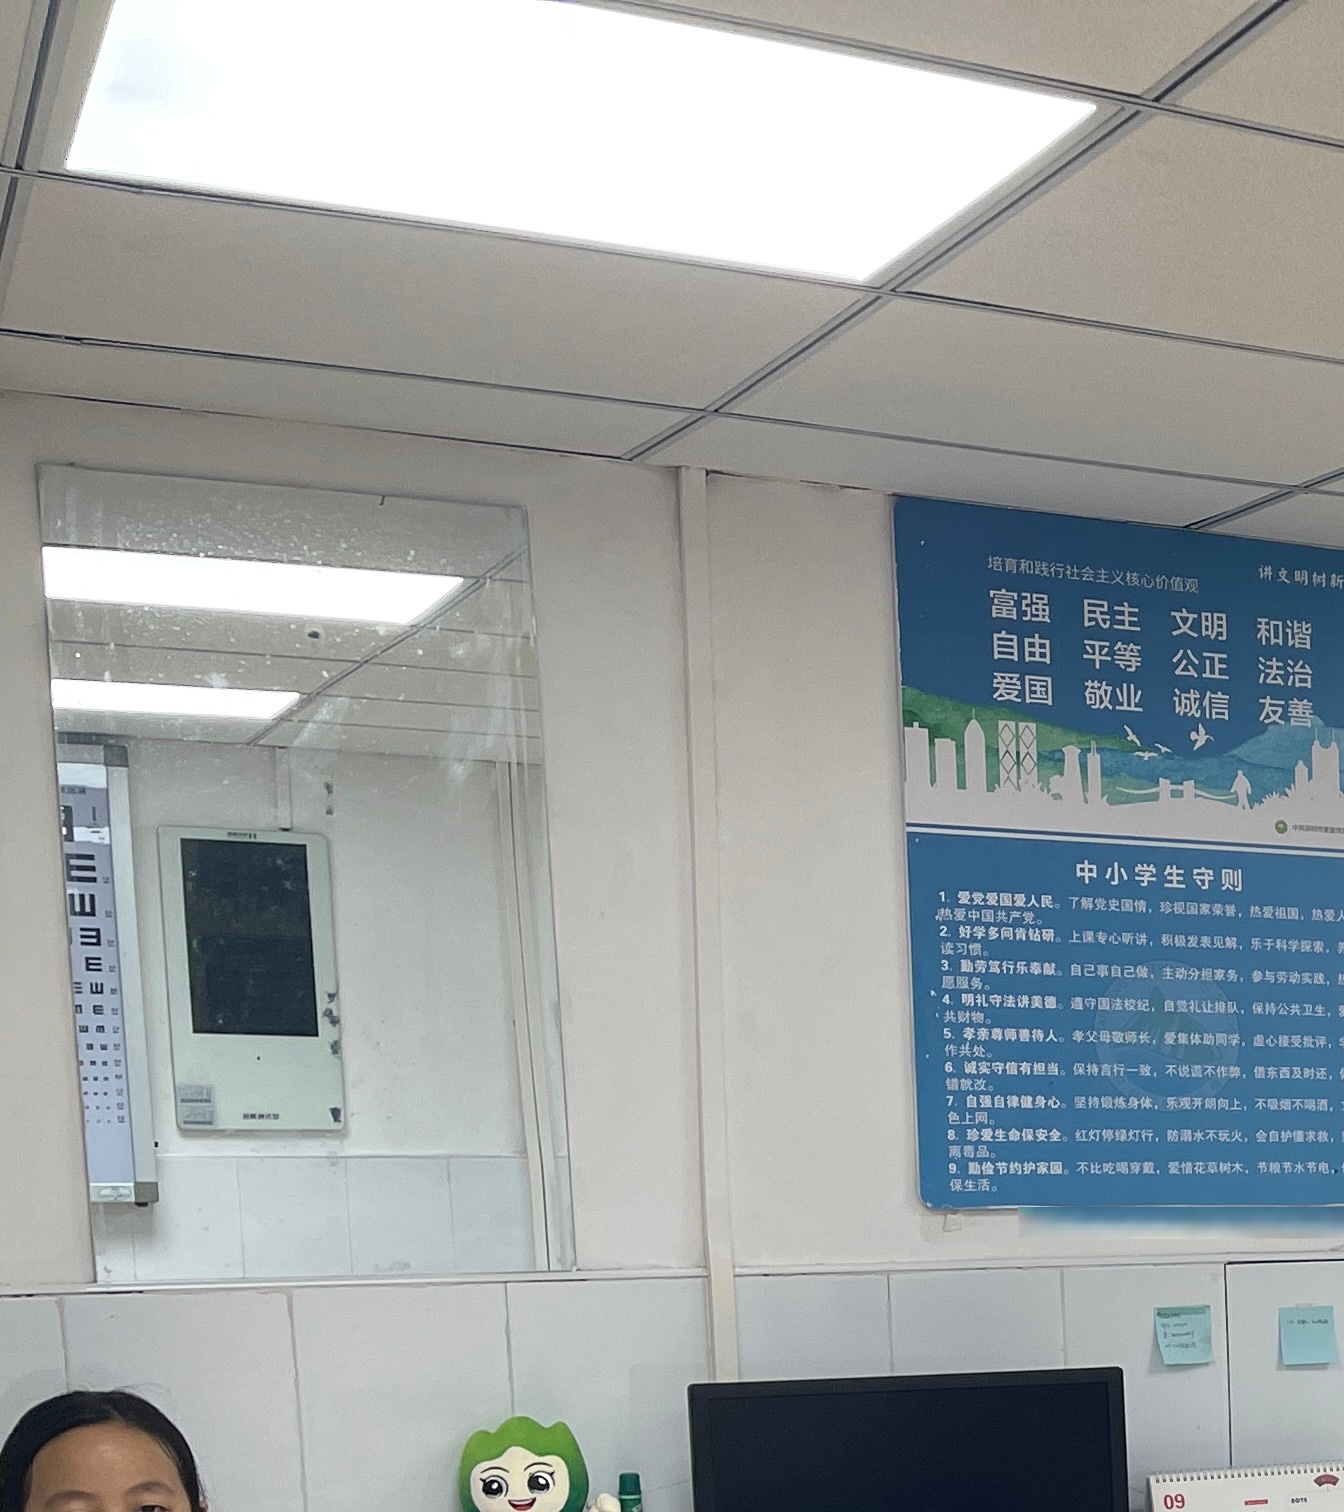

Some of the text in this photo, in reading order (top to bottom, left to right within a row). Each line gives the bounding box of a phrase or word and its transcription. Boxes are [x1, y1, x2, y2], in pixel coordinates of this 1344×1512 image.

[987, 555, 1200, 594] 培育和践行社会主义核心价值观
[988, 588, 1313, 651] 富强 民主 文明 和谐
[991, 631, 1314, 689] 自由 平等 公正 法治
[991, 671, 1315, 728] 爱国 敬业 诚信 友善
[1075, 860, 1244, 892] 中小学生守则
[940, 942, 989, 957] 读习惯。
[942, 976, 990, 991] 愿服务。
[944, 1010, 992, 1025] 共财物。
[945, 1043, 993, 1058] 作共处。
[945, 1078, 994, 1092] 错就改。
[947, 1111, 995, 1125] 色上网。
[948, 1145, 996, 1159] 离毒品。
[950, 1179, 997, 1192] 保生活。
[1163, 1493, 1186, 1510] 09
